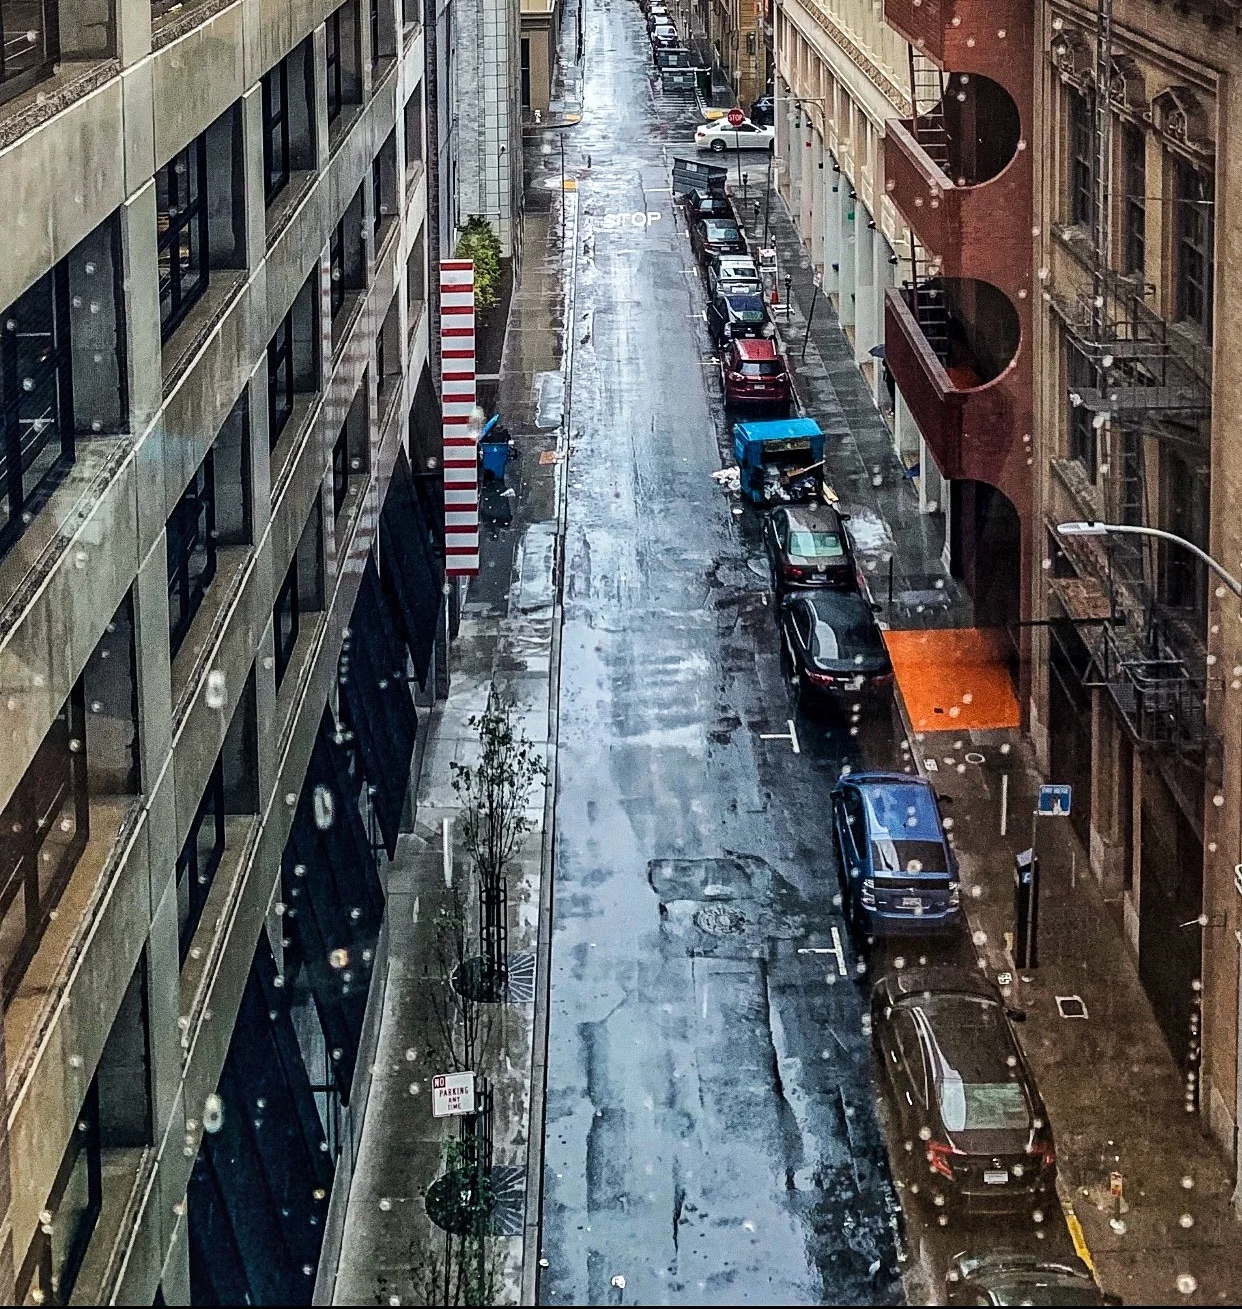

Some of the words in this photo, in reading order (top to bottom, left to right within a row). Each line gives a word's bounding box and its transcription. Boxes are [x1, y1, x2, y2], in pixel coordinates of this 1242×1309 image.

[603, 211, 662, 228] STOP
[434, 1077, 445, 1087] NO
[439, 1086, 469, 1097] PARKING
